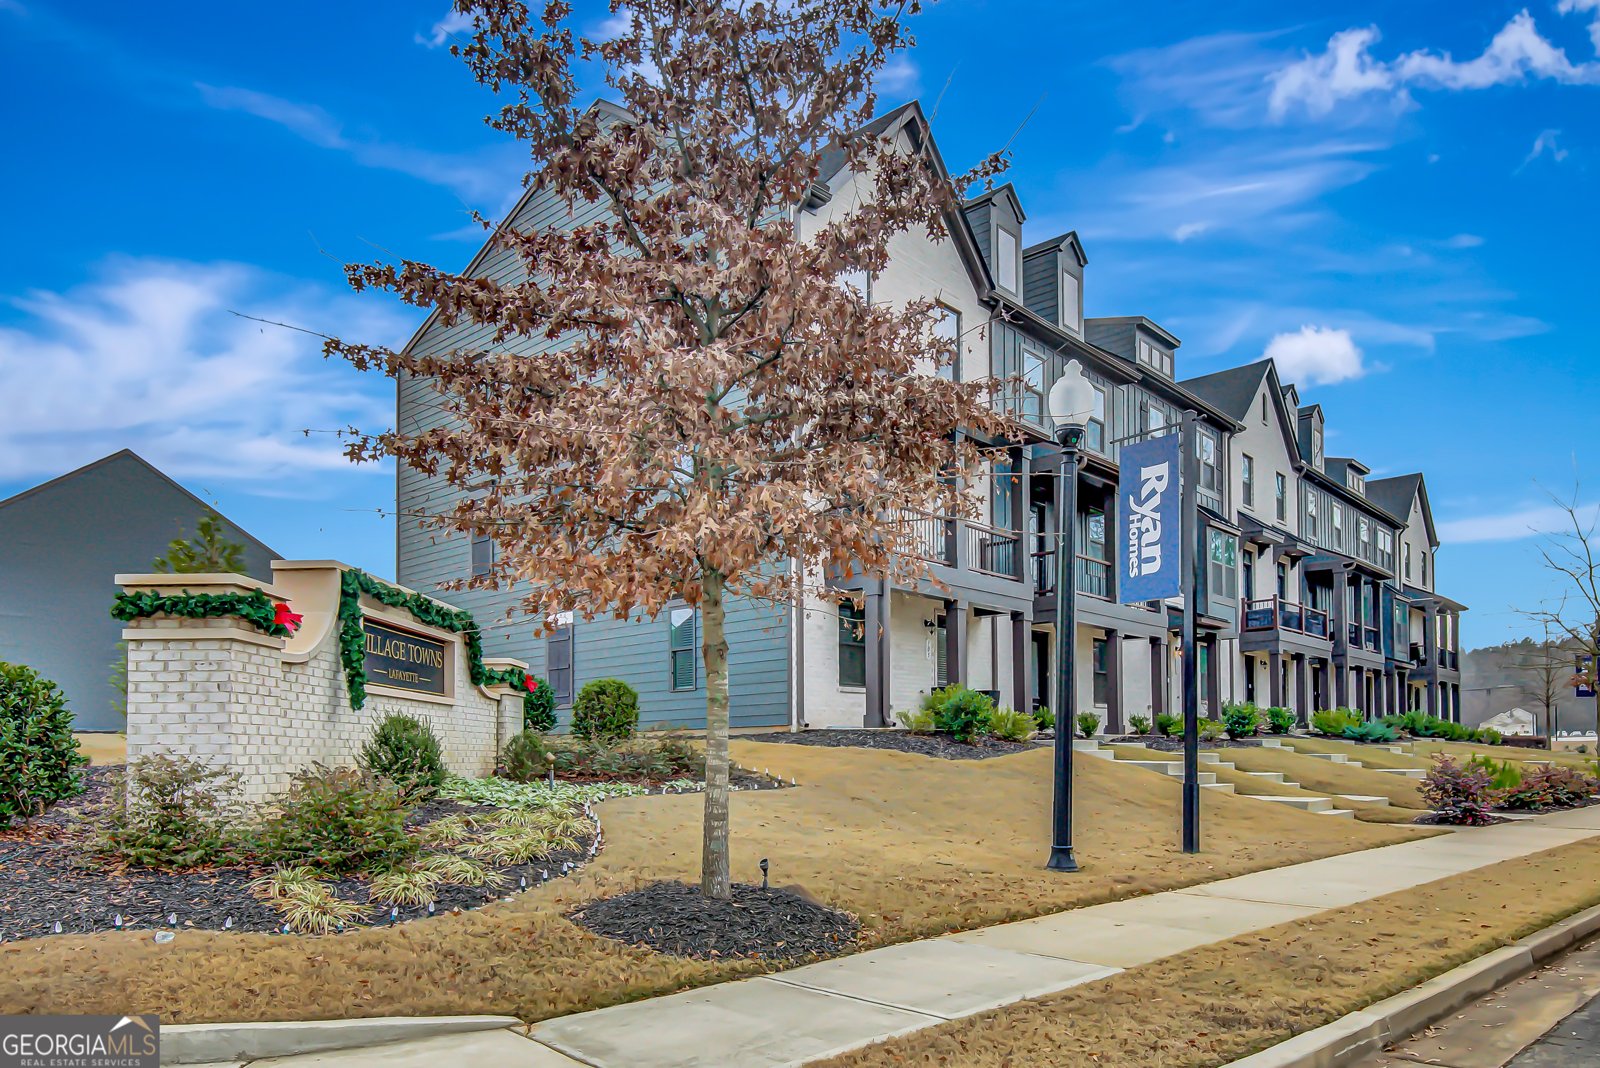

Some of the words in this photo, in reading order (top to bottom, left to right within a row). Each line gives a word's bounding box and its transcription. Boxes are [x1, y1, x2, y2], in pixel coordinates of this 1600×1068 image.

[1129, 460, 1169, 576] Ryan
[1129, 513, 1142, 578] Homes
[365, 633, 406, 661] ILLAGE
[407, 644, 443, 669] TOWNS
[388, 668, 419, 684] LAFAYETTE
